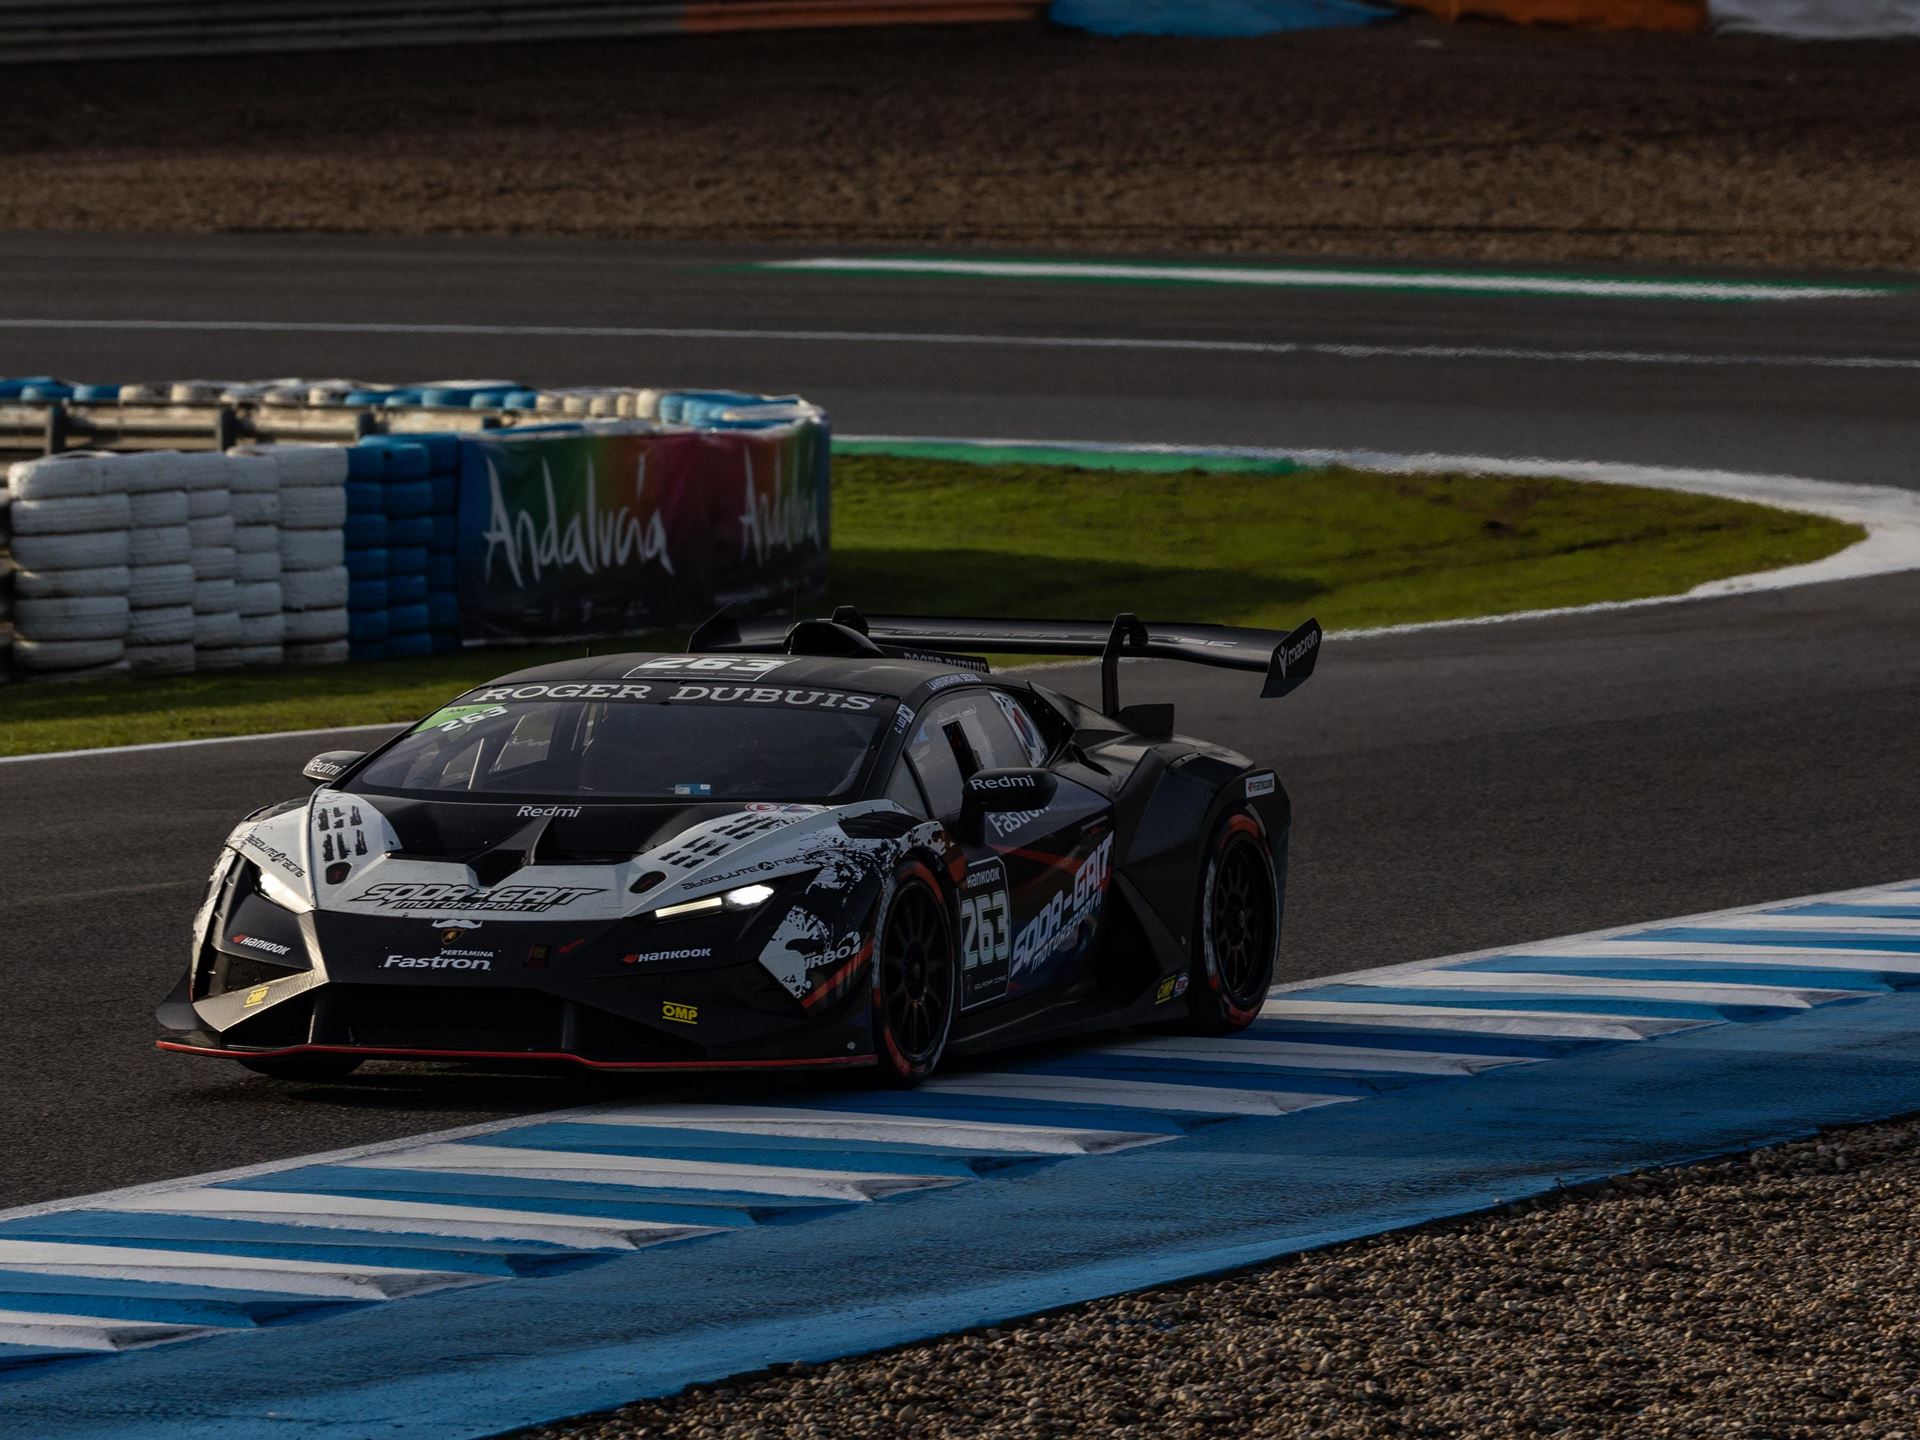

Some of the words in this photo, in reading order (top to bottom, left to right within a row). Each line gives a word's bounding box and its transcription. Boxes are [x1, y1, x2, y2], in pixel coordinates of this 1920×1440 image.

[482, 454, 676, 589] Andalucía
[638, 657, 787, 672] 263
[472, 684, 652, 702] ROGER
[669, 686, 876, 710] DUBUIS
[437, 706, 509, 732] 263
[304, 759, 347, 776] Redmi
[970, 775, 1036, 790] Redmi
[516, 806, 582, 818] Redmi
[962, 889, 1009, 971] 263
[440, 949, 494, 957] PERTAMINA
[383, 955, 491, 970] Fastron
[662, 1004, 698, 1020] OMP
